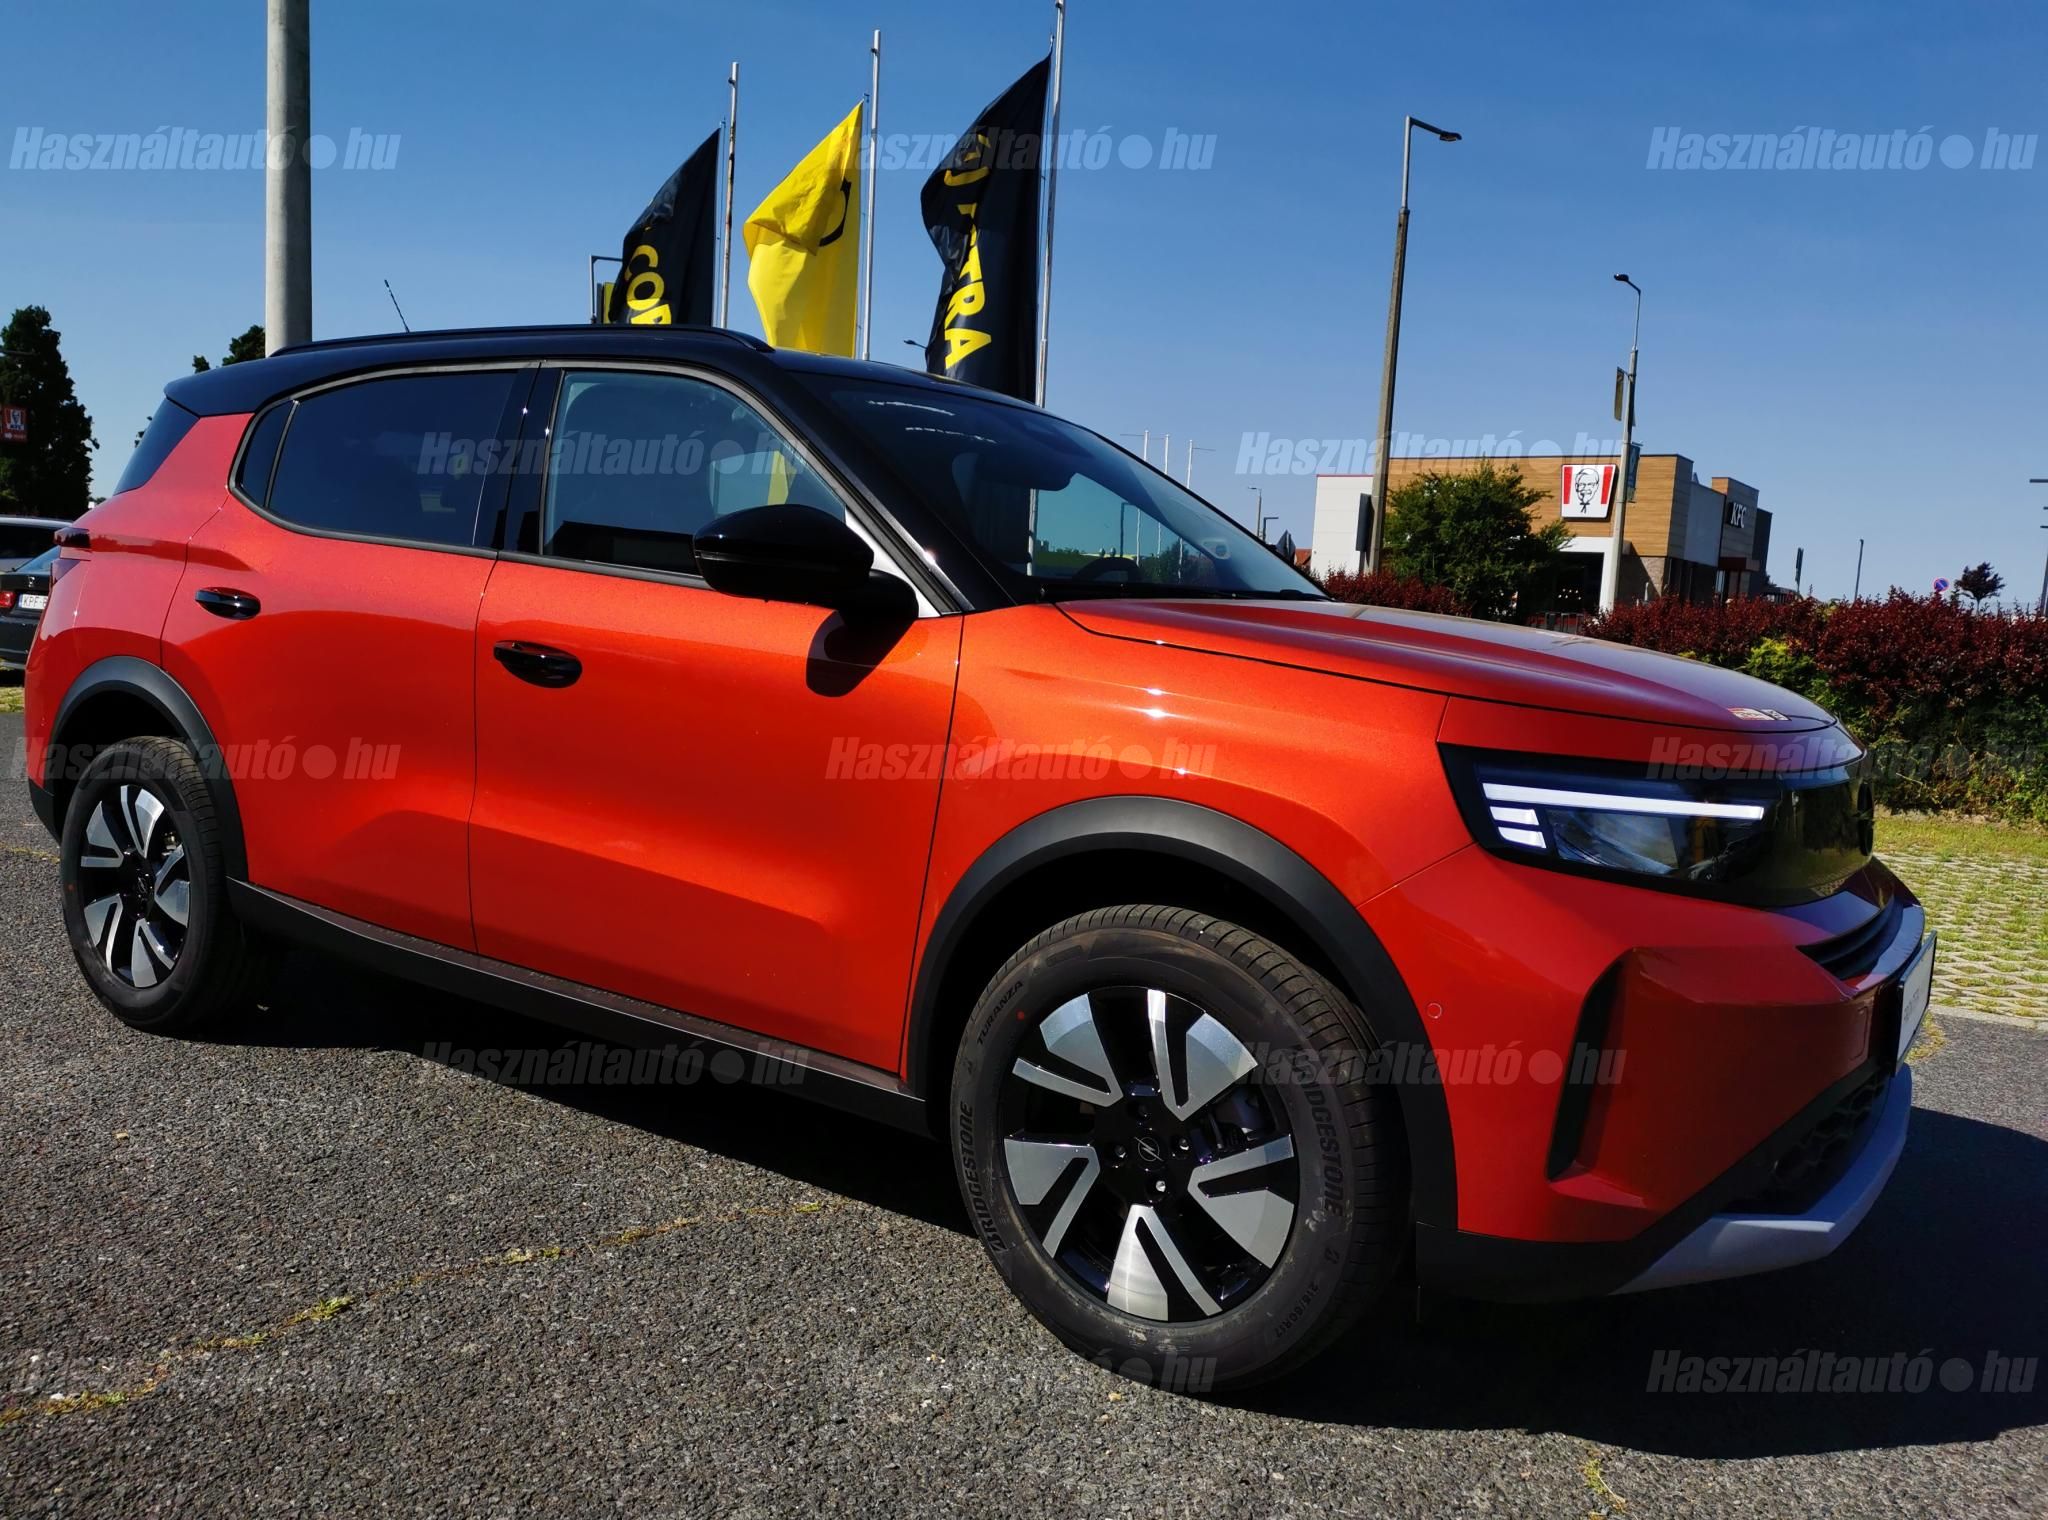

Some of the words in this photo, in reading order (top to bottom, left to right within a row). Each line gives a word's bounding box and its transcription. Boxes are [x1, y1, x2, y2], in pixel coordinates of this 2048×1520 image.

[1730, 502, 1747, 529] KFC
[976, 979, 1023, 1046] TURANZA
[959, 1101, 1008, 1252] BRIDGESTONE
